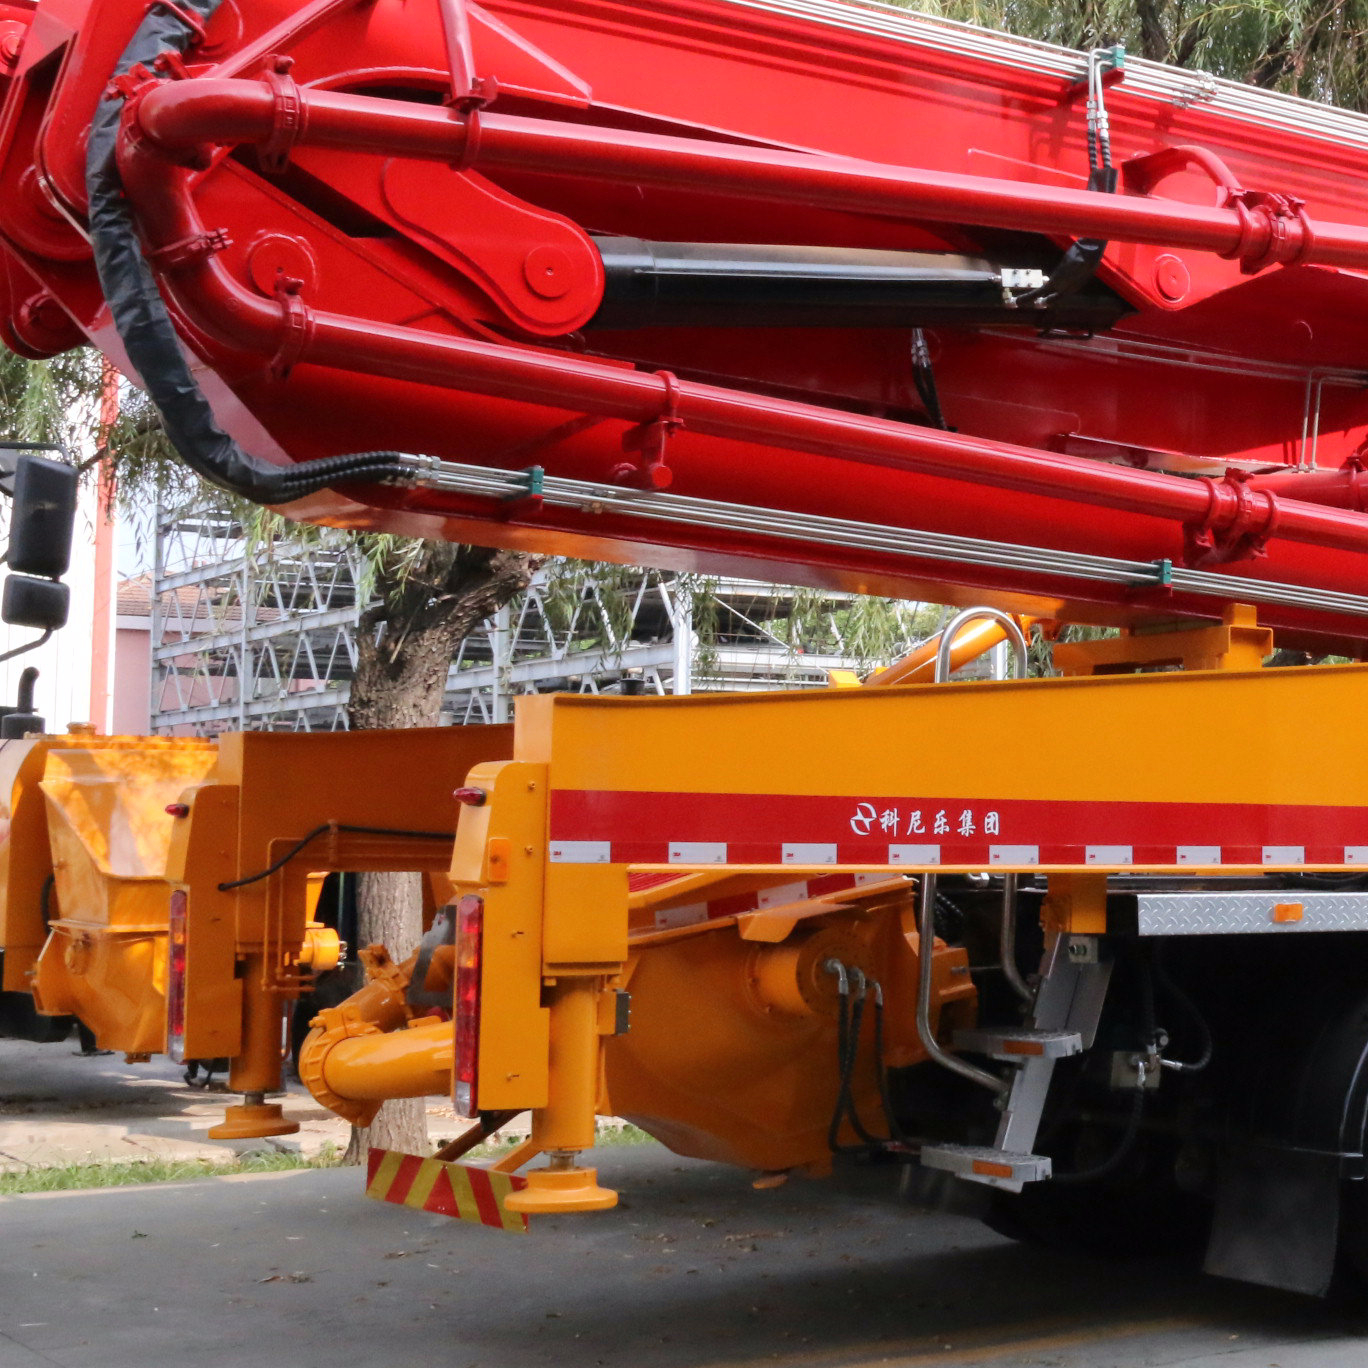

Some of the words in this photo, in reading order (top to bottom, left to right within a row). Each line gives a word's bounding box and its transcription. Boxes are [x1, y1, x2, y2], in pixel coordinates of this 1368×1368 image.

[879, 807, 1000, 837] 科尼乐集团
